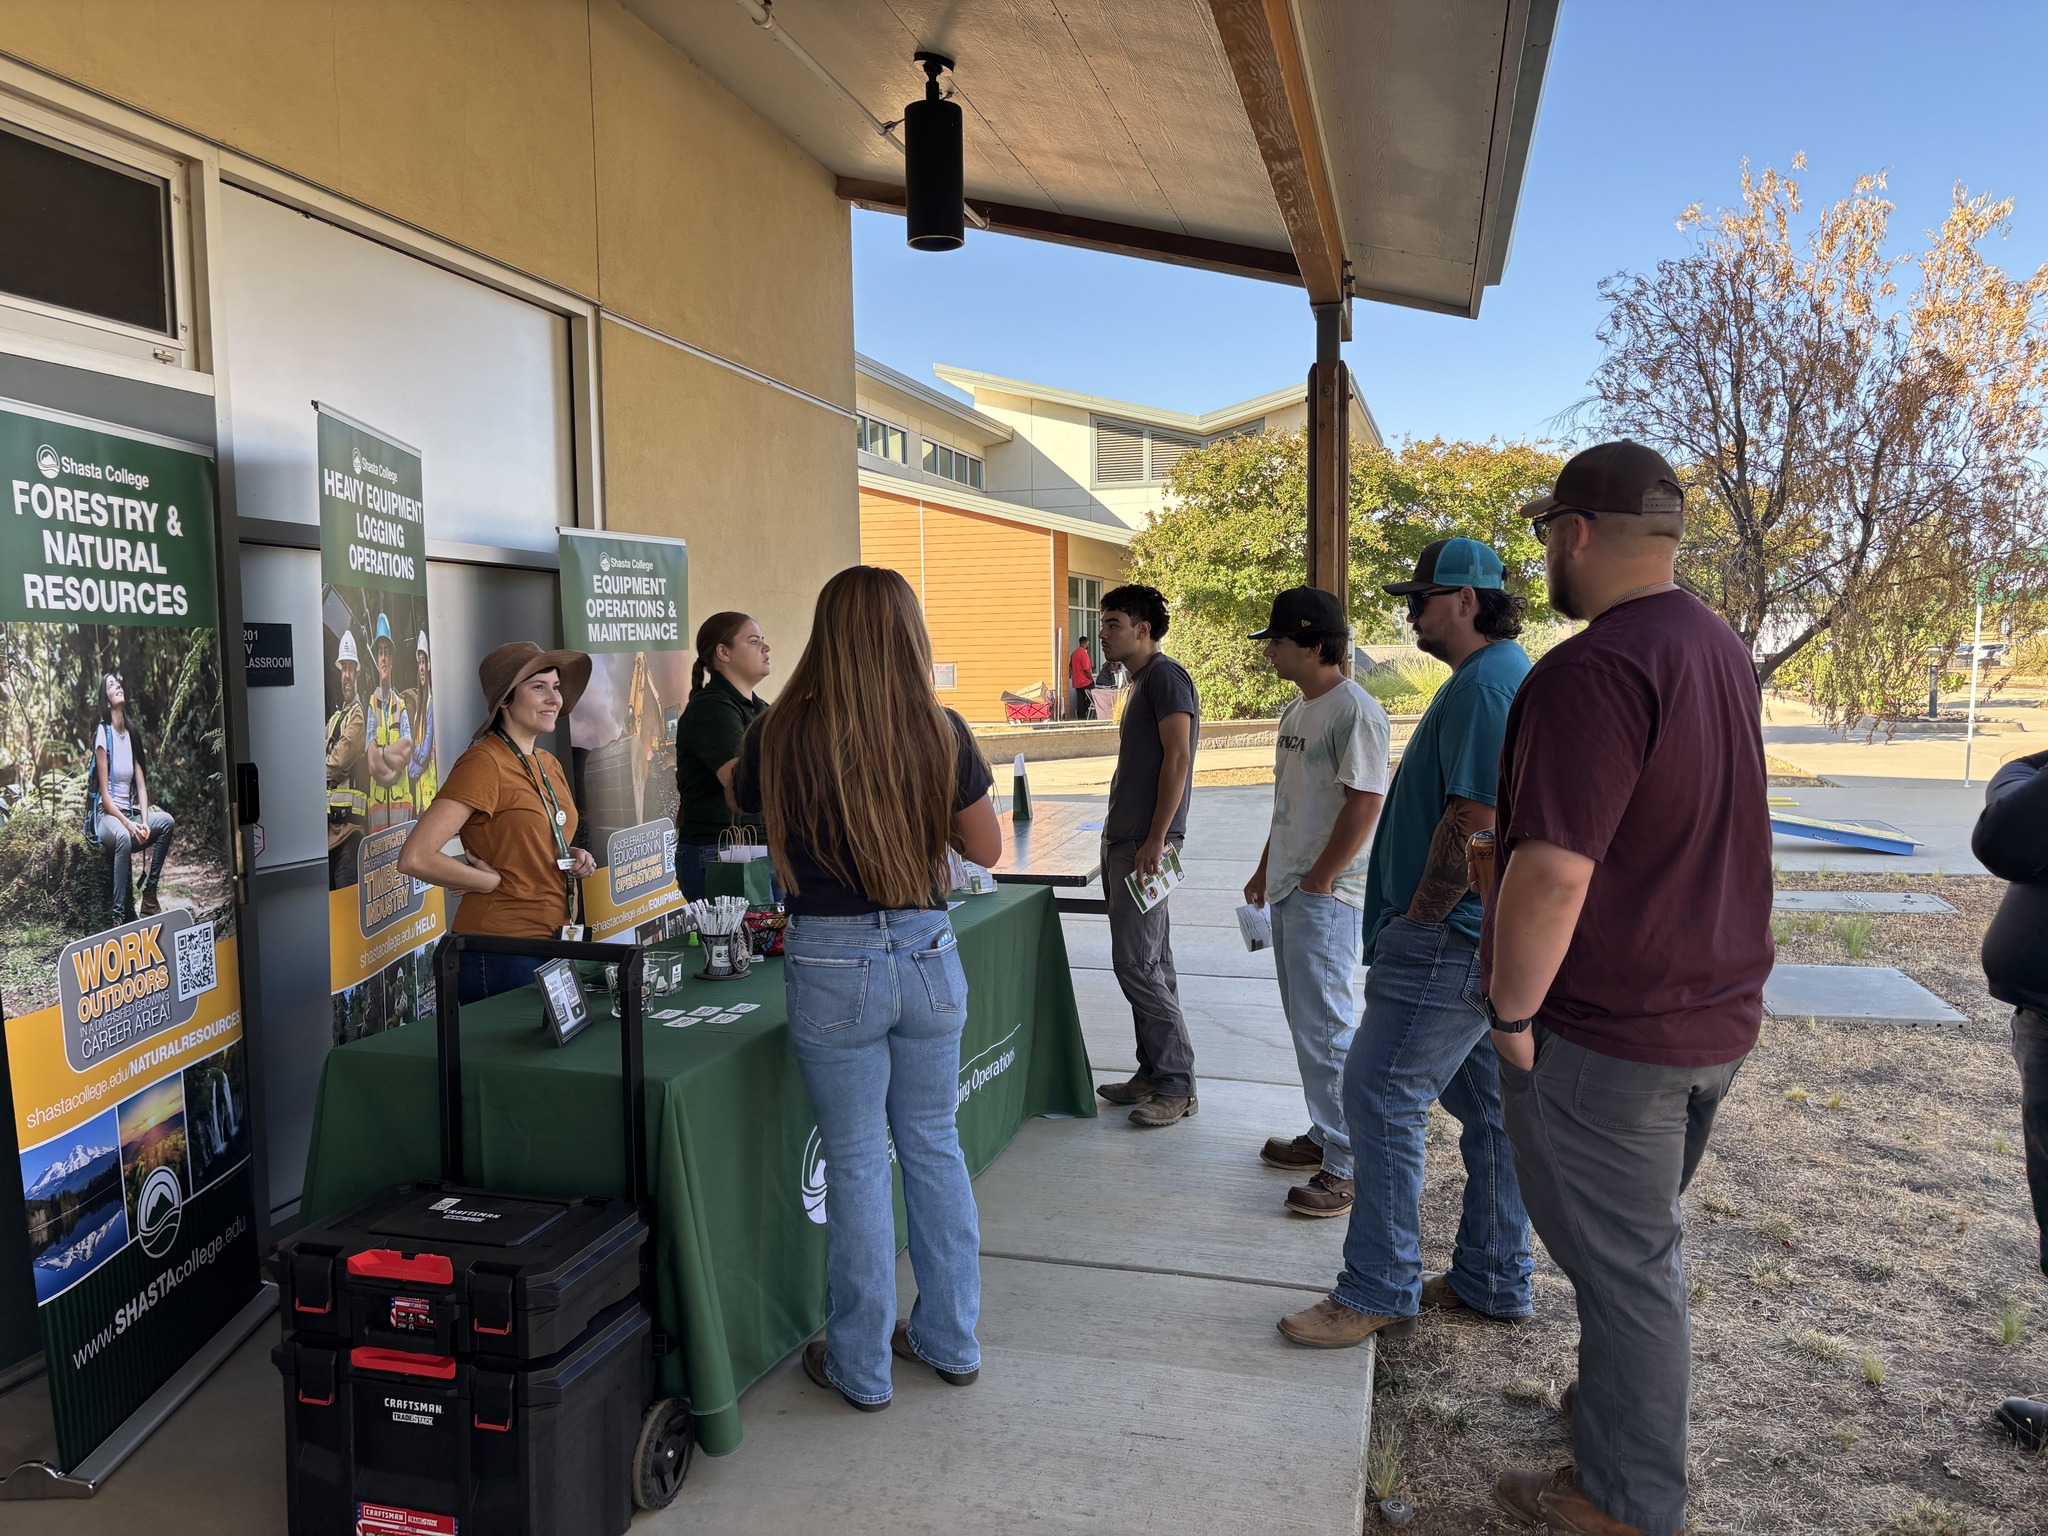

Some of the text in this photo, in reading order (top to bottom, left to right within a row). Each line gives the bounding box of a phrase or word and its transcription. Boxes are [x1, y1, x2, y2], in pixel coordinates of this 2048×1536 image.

[61, 456, 150, 491] Shasta College
[361, 457, 398, 485] Shasta College
[12, 479, 184, 537] FORESTRY &
[324, 468, 422, 524] HEAVY EQUIPMENT
[356, 512, 405, 548] LOGGING
[42, 529, 168, 575] NATURAL
[349, 543, 415, 581] OPERATIONS
[610, 557, 654, 572] Shasta College
[23, 573, 189, 616] RESOURCES
[592, 574, 667, 596] EQUIPMENT
[585, 598, 678, 618] OPERATIONS &
[587, 622, 679, 642] MAINTENANCE
[363, 843, 370, 861] A
[613, 828, 661, 851] ACCELERATE YOUR
[614, 839, 662, 866] EDUCATION IN
[614, 863, 633, 879] HEAVY
[615, 863, 664, 894] OPERATIONS
[365, 884, 410, 928] INDUSTRY
[360, 912, 437, 968] shastacollege.edu/HELO
[71, 922, 166, 994] WORK
[77, 964, 170, 1024] OUTDOORS
[80, 989, 170, 1039] IN A DIVERSIFIED GROWING
[81, 1002, 171, 1059] CAREER AREA!
[27, 1010, 241, 1129] shastacollege.edu/NATURALRESOURCES
[443, 1209, 502, 1219] CRAFTSMAN
[72, 1214, 247, 1371] www.SHASTAcollege.edu
[384, 1397, 443, 1415] CRAFTSMAN
[365, 1505, 404, 1521] CRAFTSMAN
